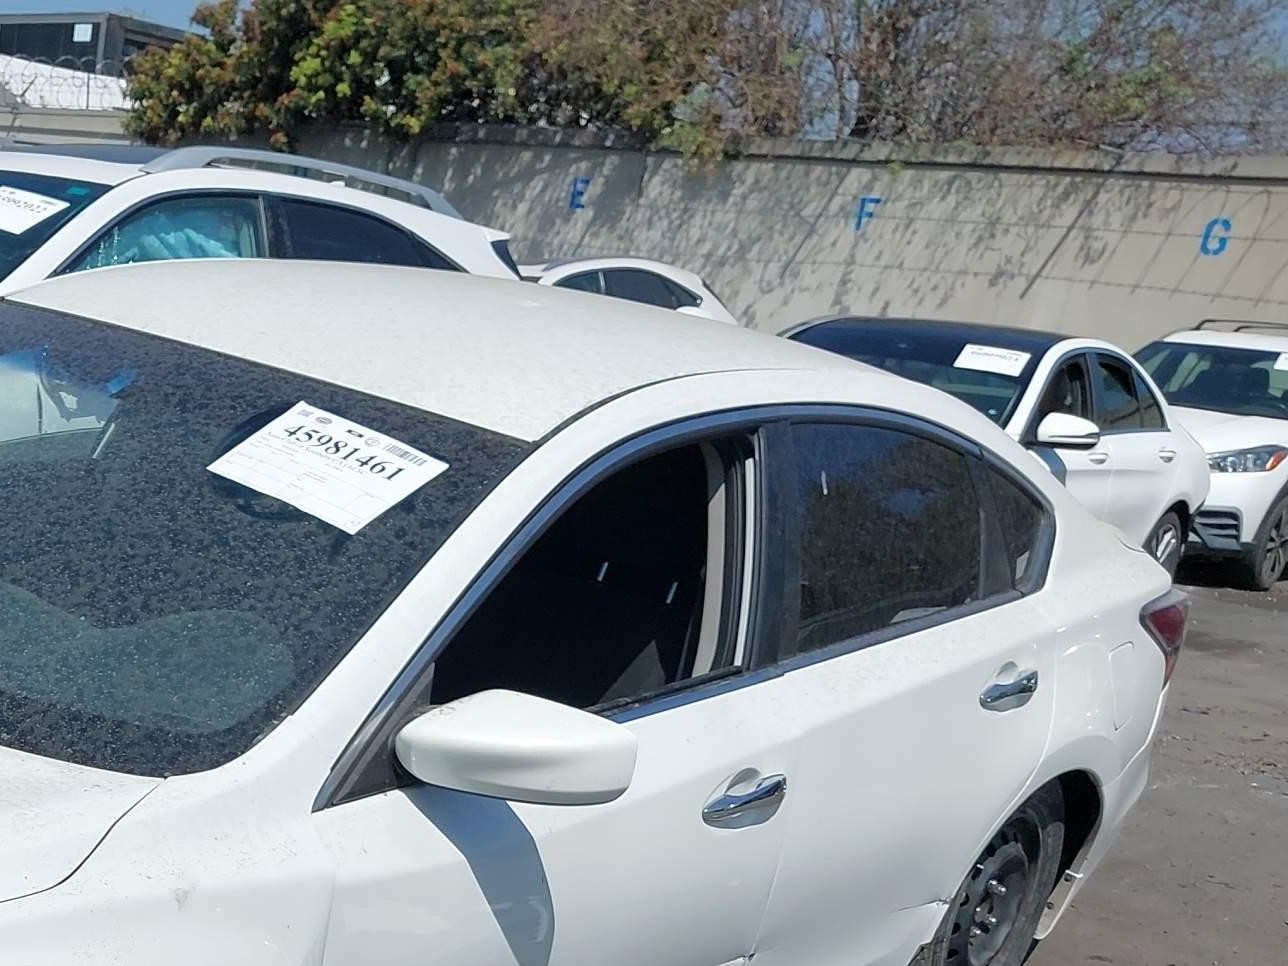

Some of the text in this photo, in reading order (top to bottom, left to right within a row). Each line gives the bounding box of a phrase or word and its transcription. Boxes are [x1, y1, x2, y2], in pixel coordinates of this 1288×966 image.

[569, 177, 591, 209] E
[855, 197, 881, 231] F
[1201, 218, 1231, 256] G
[284, 425, 405, 481] 45981461
